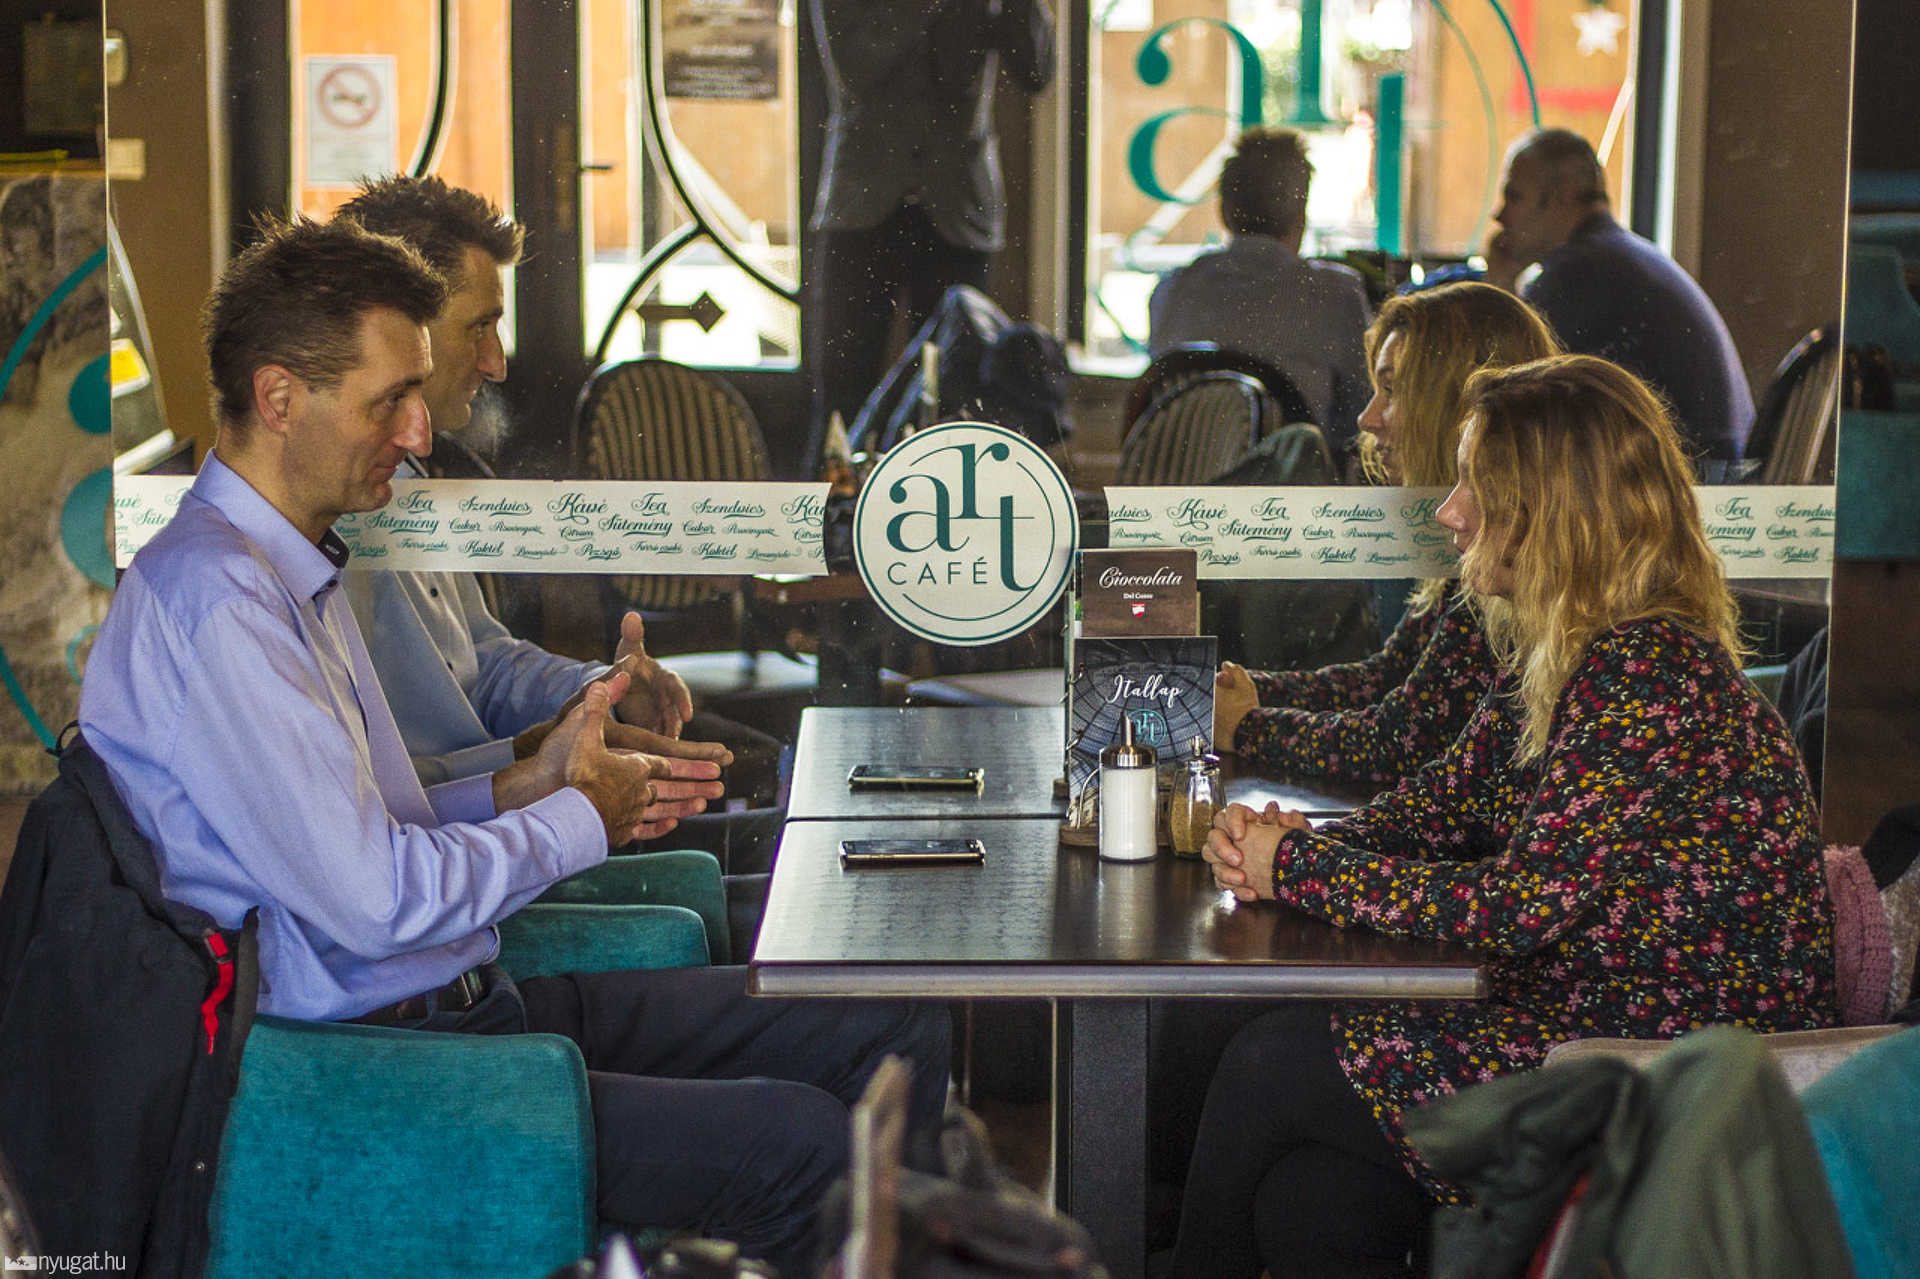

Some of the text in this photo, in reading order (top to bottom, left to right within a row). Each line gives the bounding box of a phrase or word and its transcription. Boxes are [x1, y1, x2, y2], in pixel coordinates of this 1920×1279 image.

[397, 489, 437, 515] Tea
[459, 495, 532, 517] Szendvics
[547, 493, 609, 525] Kávé
[631, 493, 670, 517] Tea
[692, 498, 766, 519] Szendvics
[886, 442, 1035, 592] art
[1166, 498, 1228, 530] Kávé
[1251, 497, 1290, 521] Tea
[1312, 502, 1385, 523] Szendvics
[1715, 497, 1754, 521] Tea
[599, 513, 673, 538] Sütemény
[1217, 519, 1292, 542] Sütemény
[887, 556, 988, 586] CAFÉ
[1098, 565, 1184, 589] Cioccolata
[1105, 673, 1184, 709] Itallap
